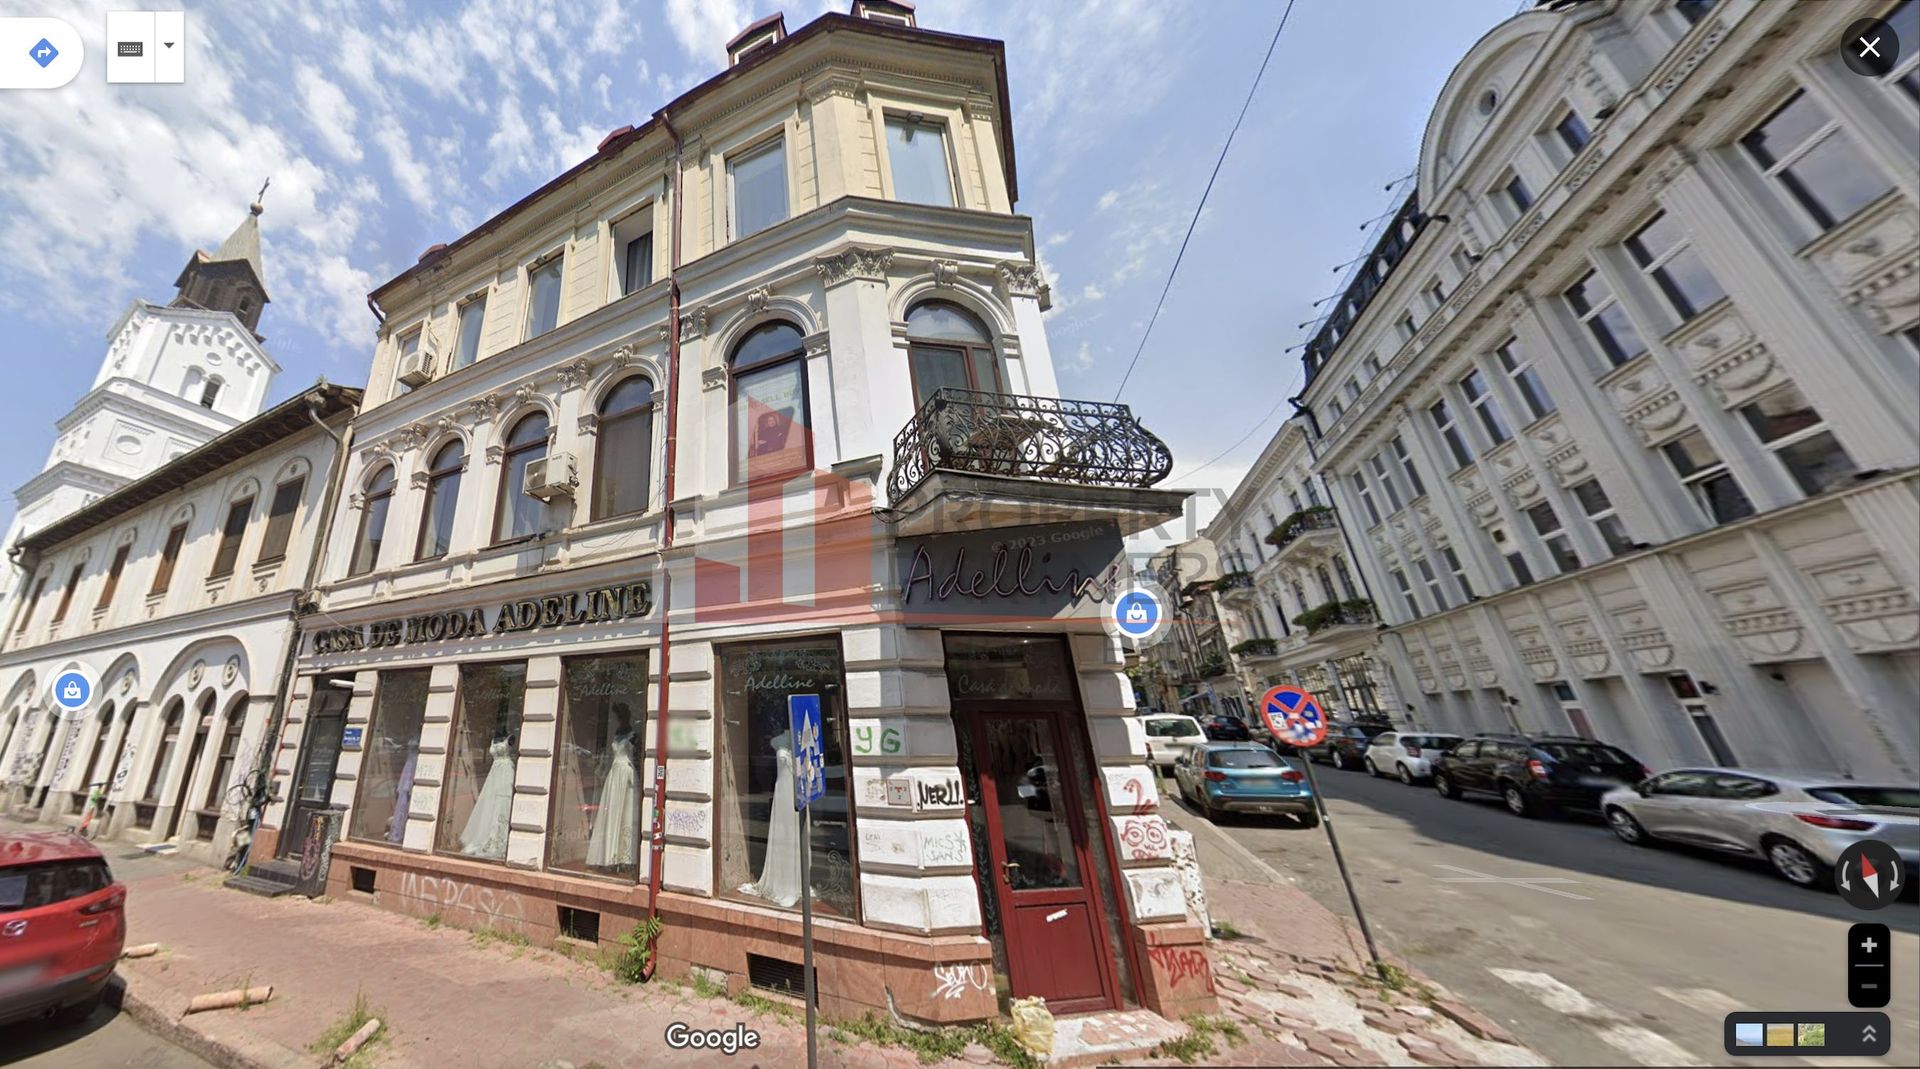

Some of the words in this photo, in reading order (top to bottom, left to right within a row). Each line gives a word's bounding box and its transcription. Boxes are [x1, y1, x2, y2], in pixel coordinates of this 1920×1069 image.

[904, 542, 1122, 607] Adelline
[403, 608, 488, 645] MODA
[492, 581, 652, 633] ADELINE
[744, 673, 816, 692] Adelline
